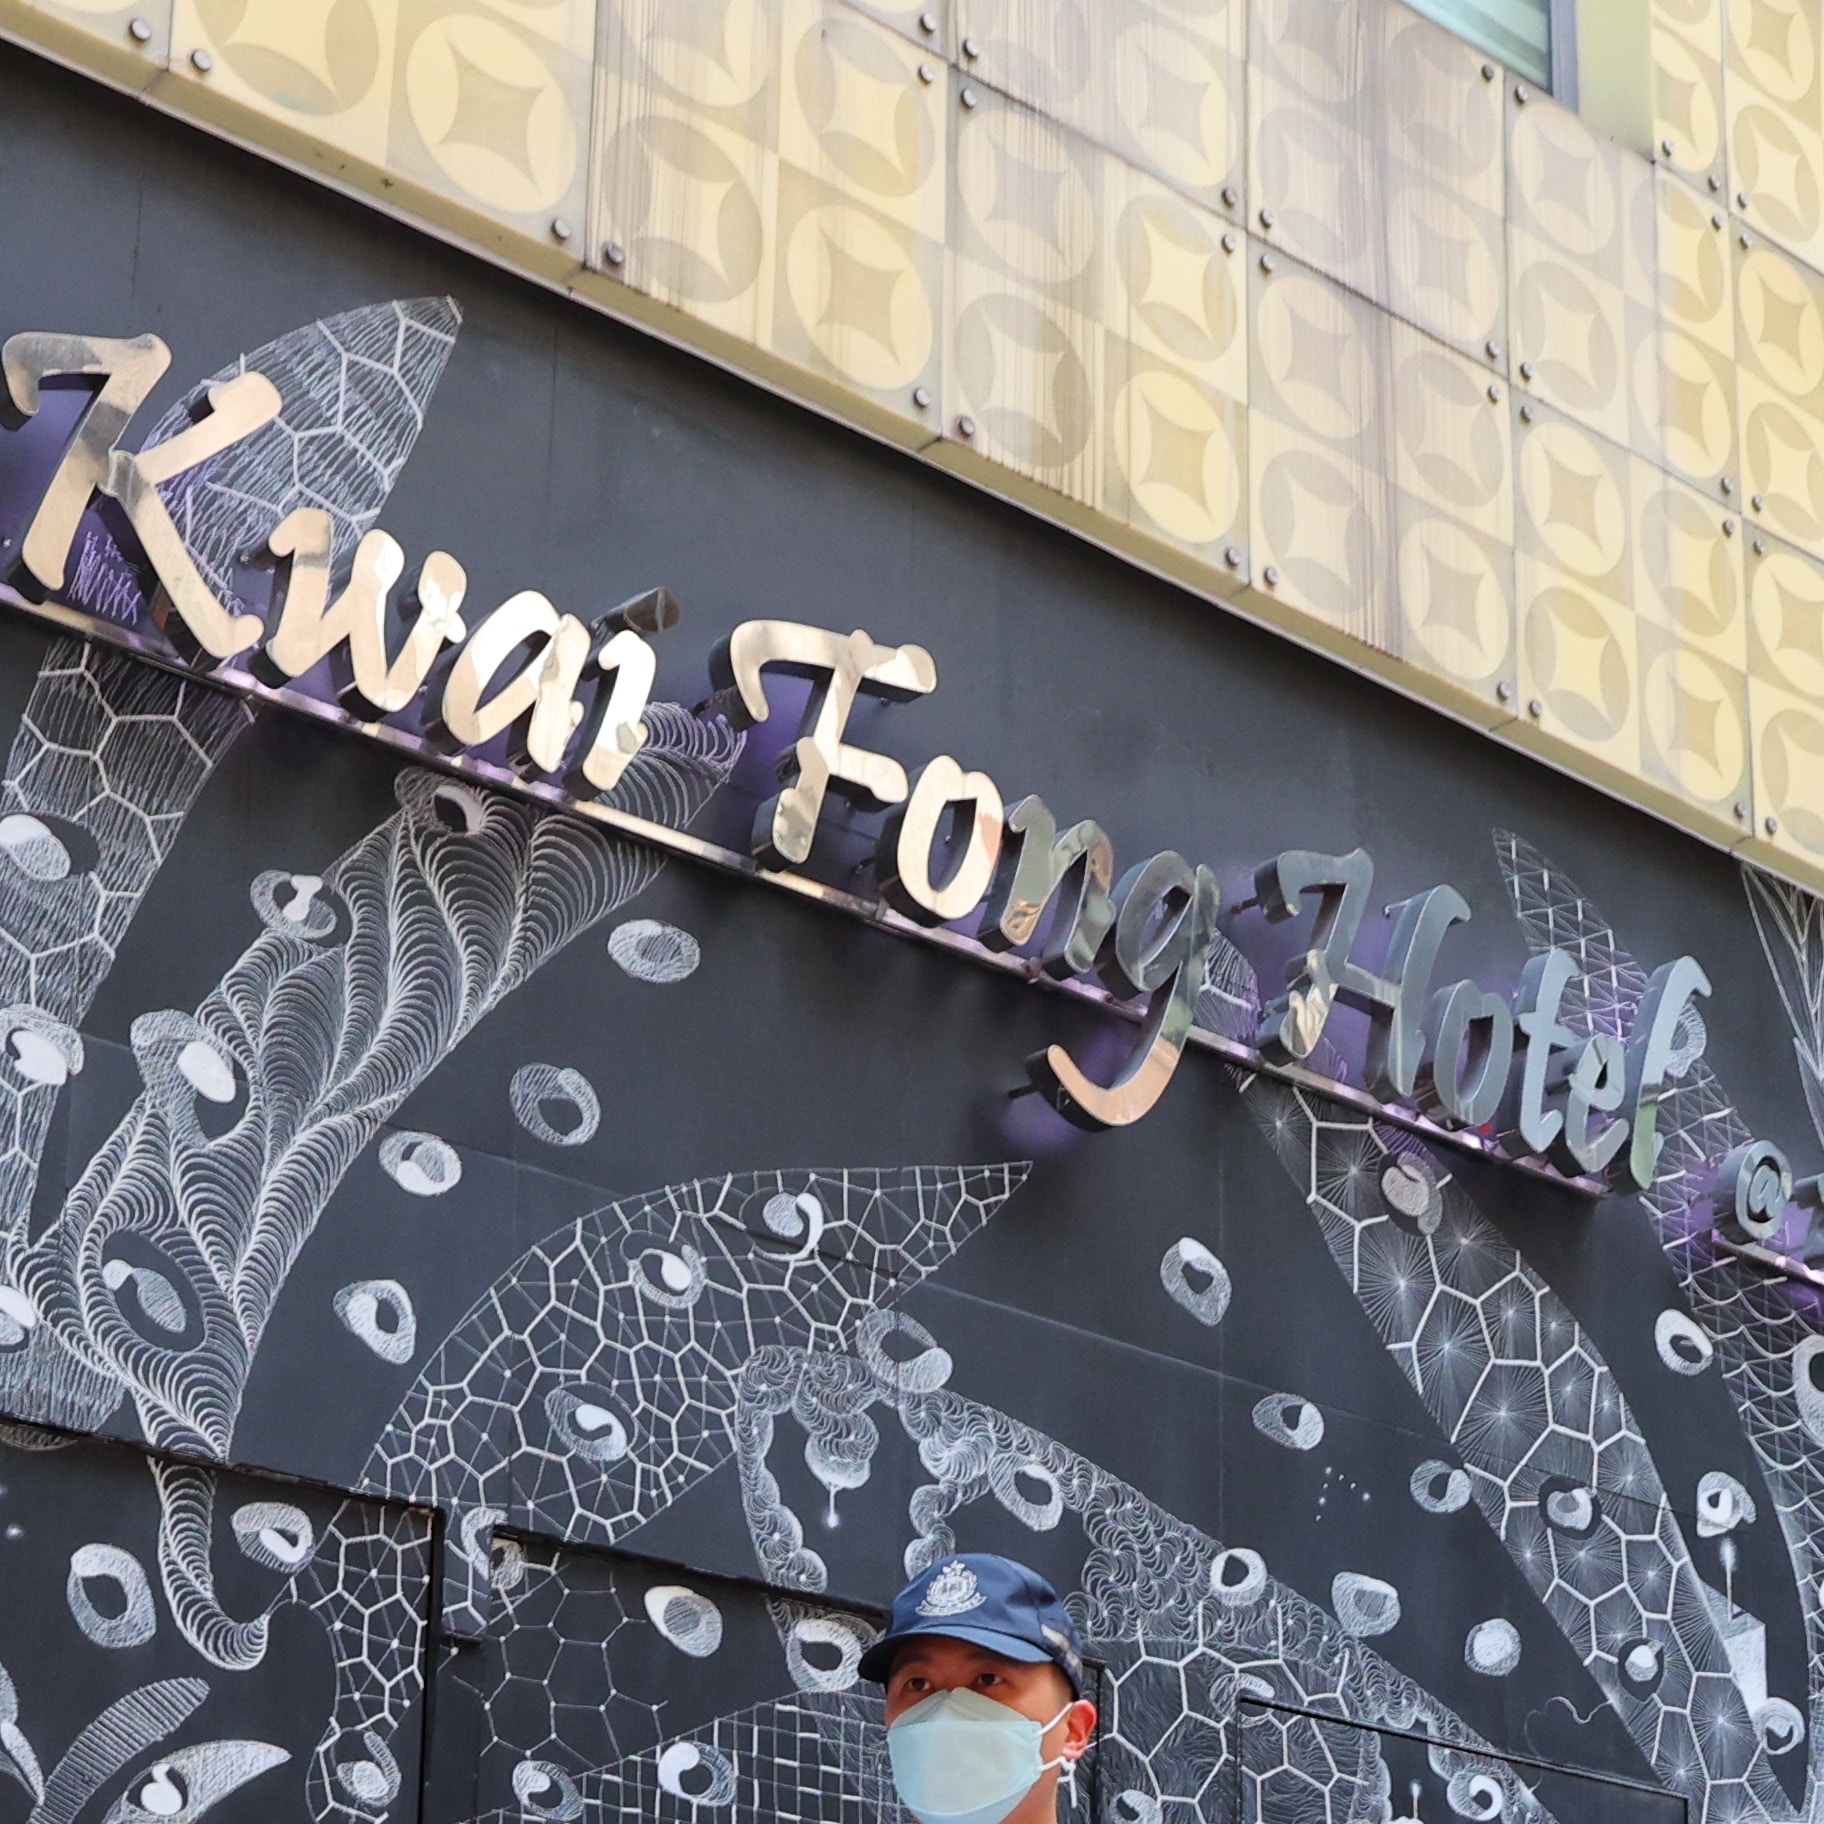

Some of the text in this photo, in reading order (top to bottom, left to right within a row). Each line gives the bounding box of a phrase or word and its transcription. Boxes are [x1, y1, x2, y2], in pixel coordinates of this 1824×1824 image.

[0, 331, 680, 791] Kwai
[728, 619, 1221, 1127] Fong
[1276, 847, 1713, 1191] Hotel
